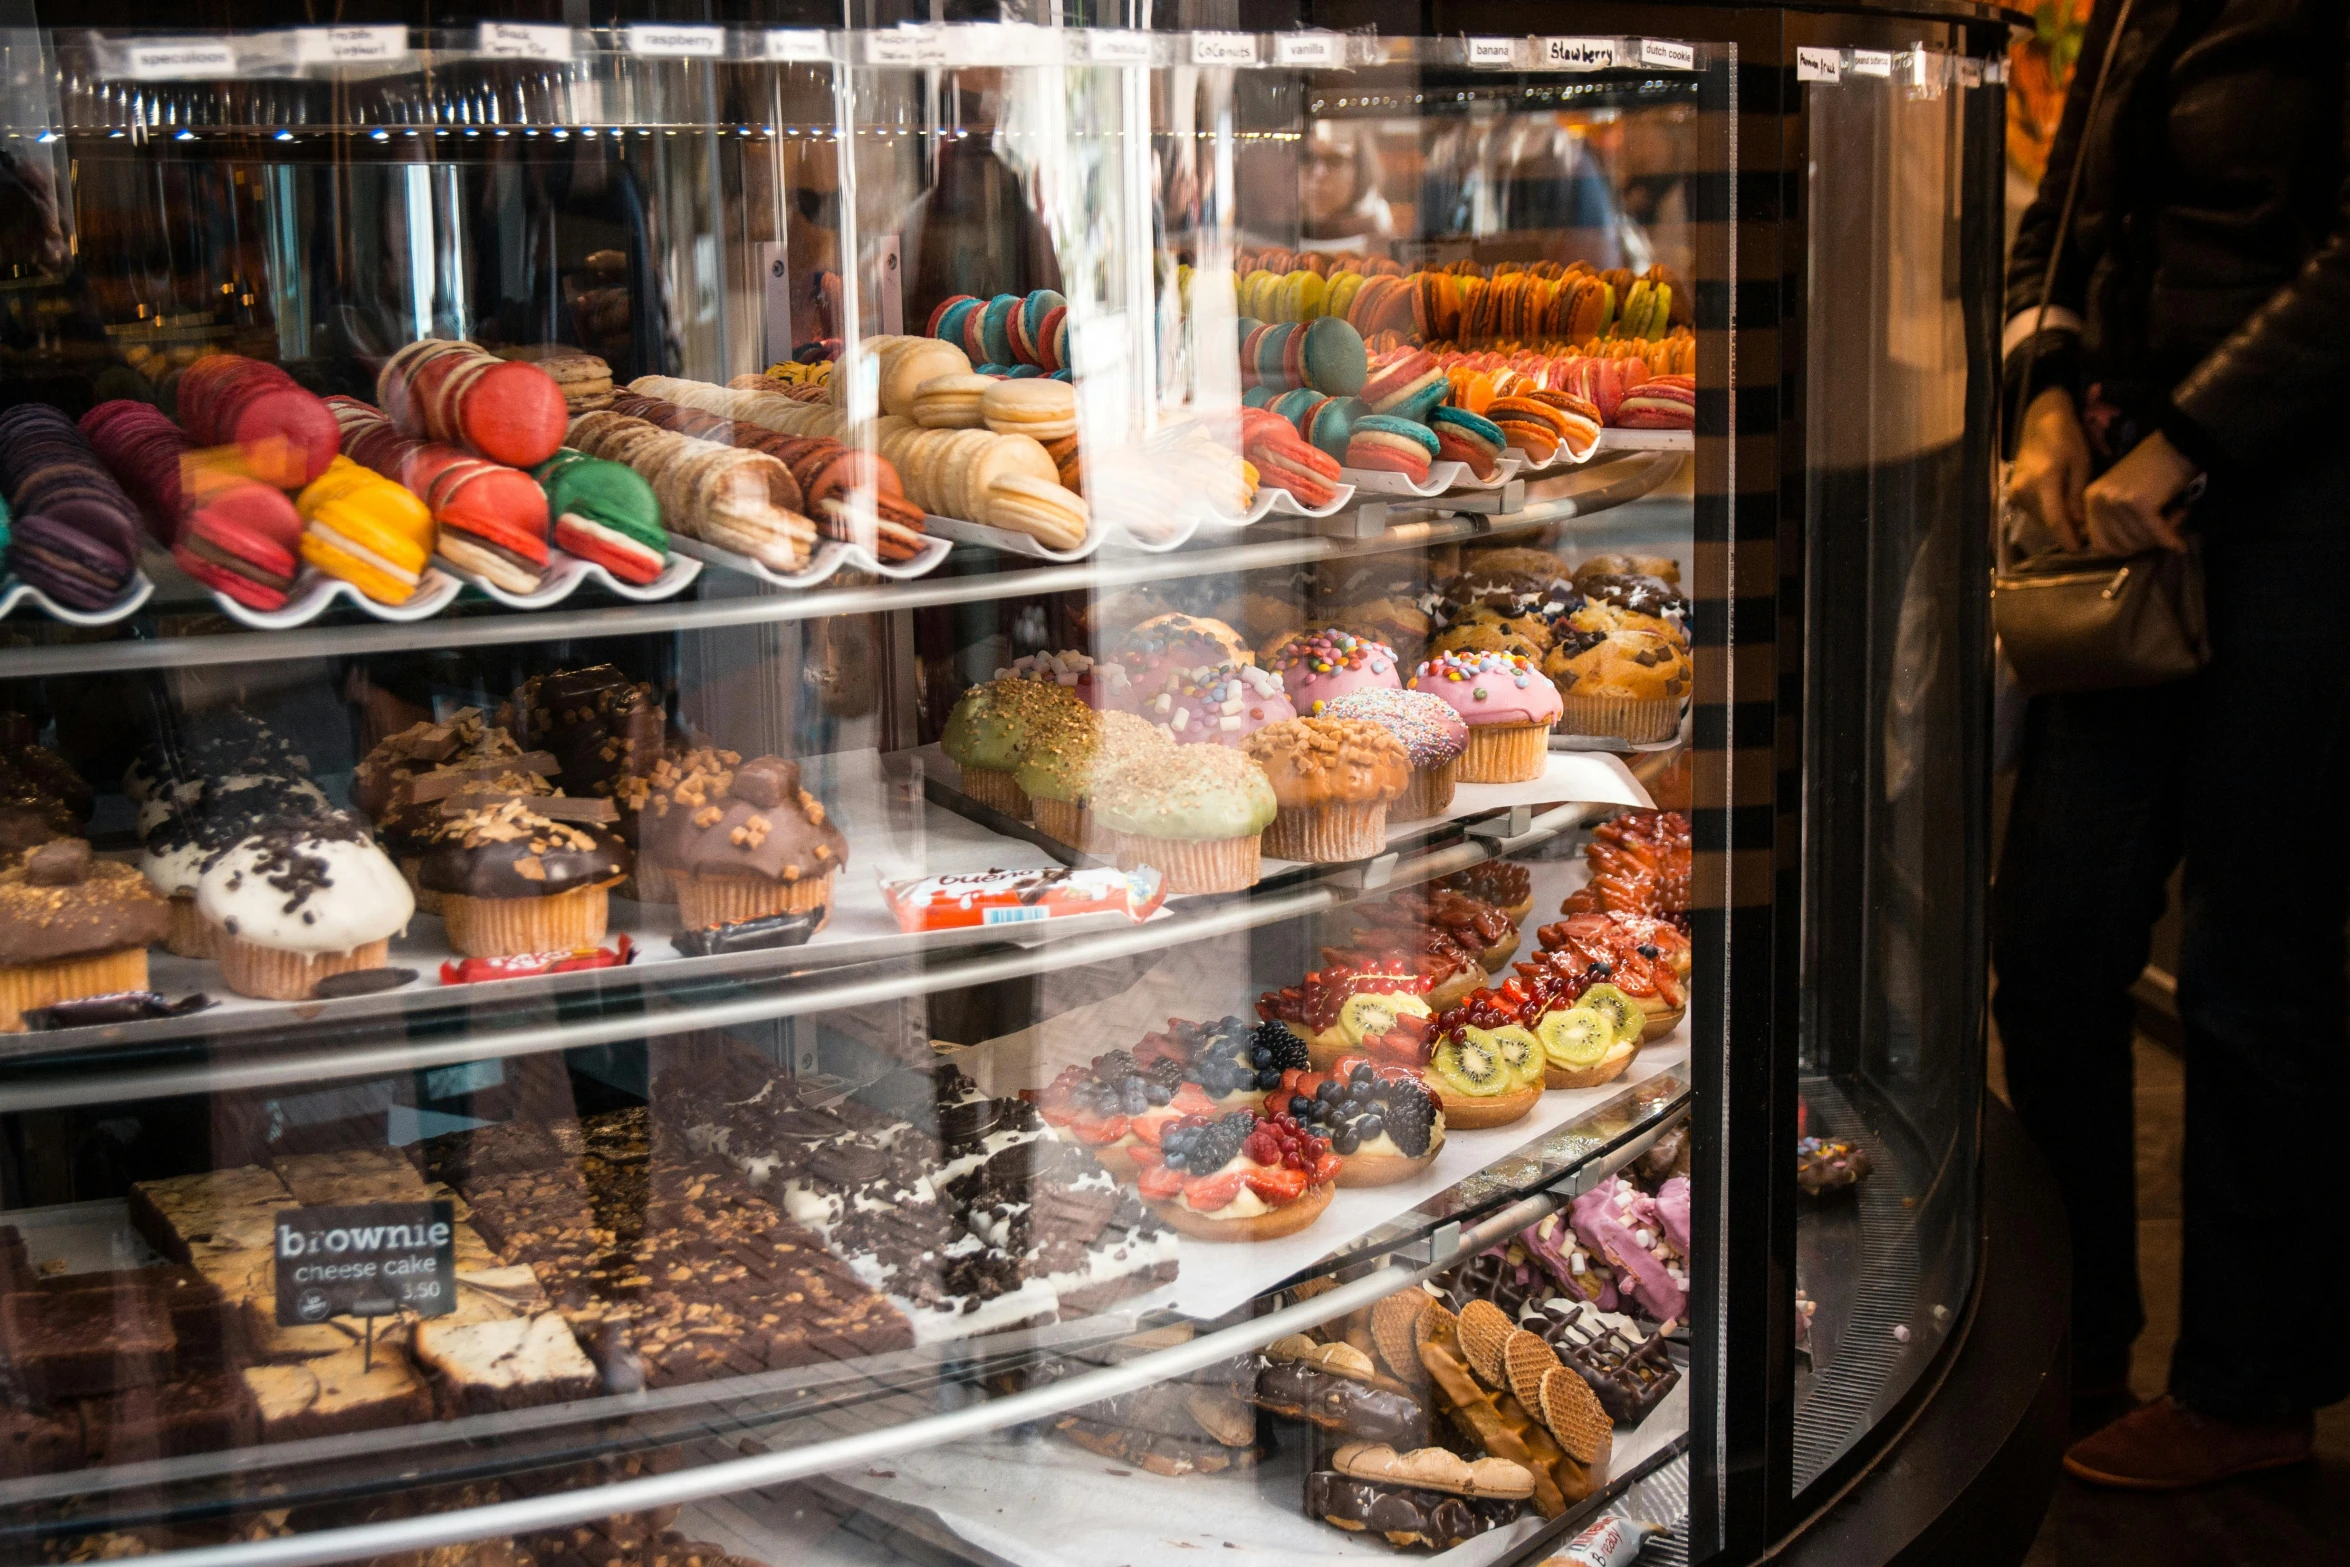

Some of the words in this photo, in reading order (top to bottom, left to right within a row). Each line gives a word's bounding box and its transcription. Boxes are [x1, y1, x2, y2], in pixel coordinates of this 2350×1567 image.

[644, 34, 713, 50] raspberry
[1290, 44, 1325, 55] vanilla
[1476, 44, 1509, 56] banana
[1550, 40, 1613, 66] Stawberry
[1646, 44, 1667, 57] dutch
[1668, 50, 1691, 62] cookie
[939, 870, 1035, 886] bueno
[278, 1217, 450, 1257] brownie
[295, 1261, 378, 1282] cheese
[383, 1254, 438, 1276] cake
